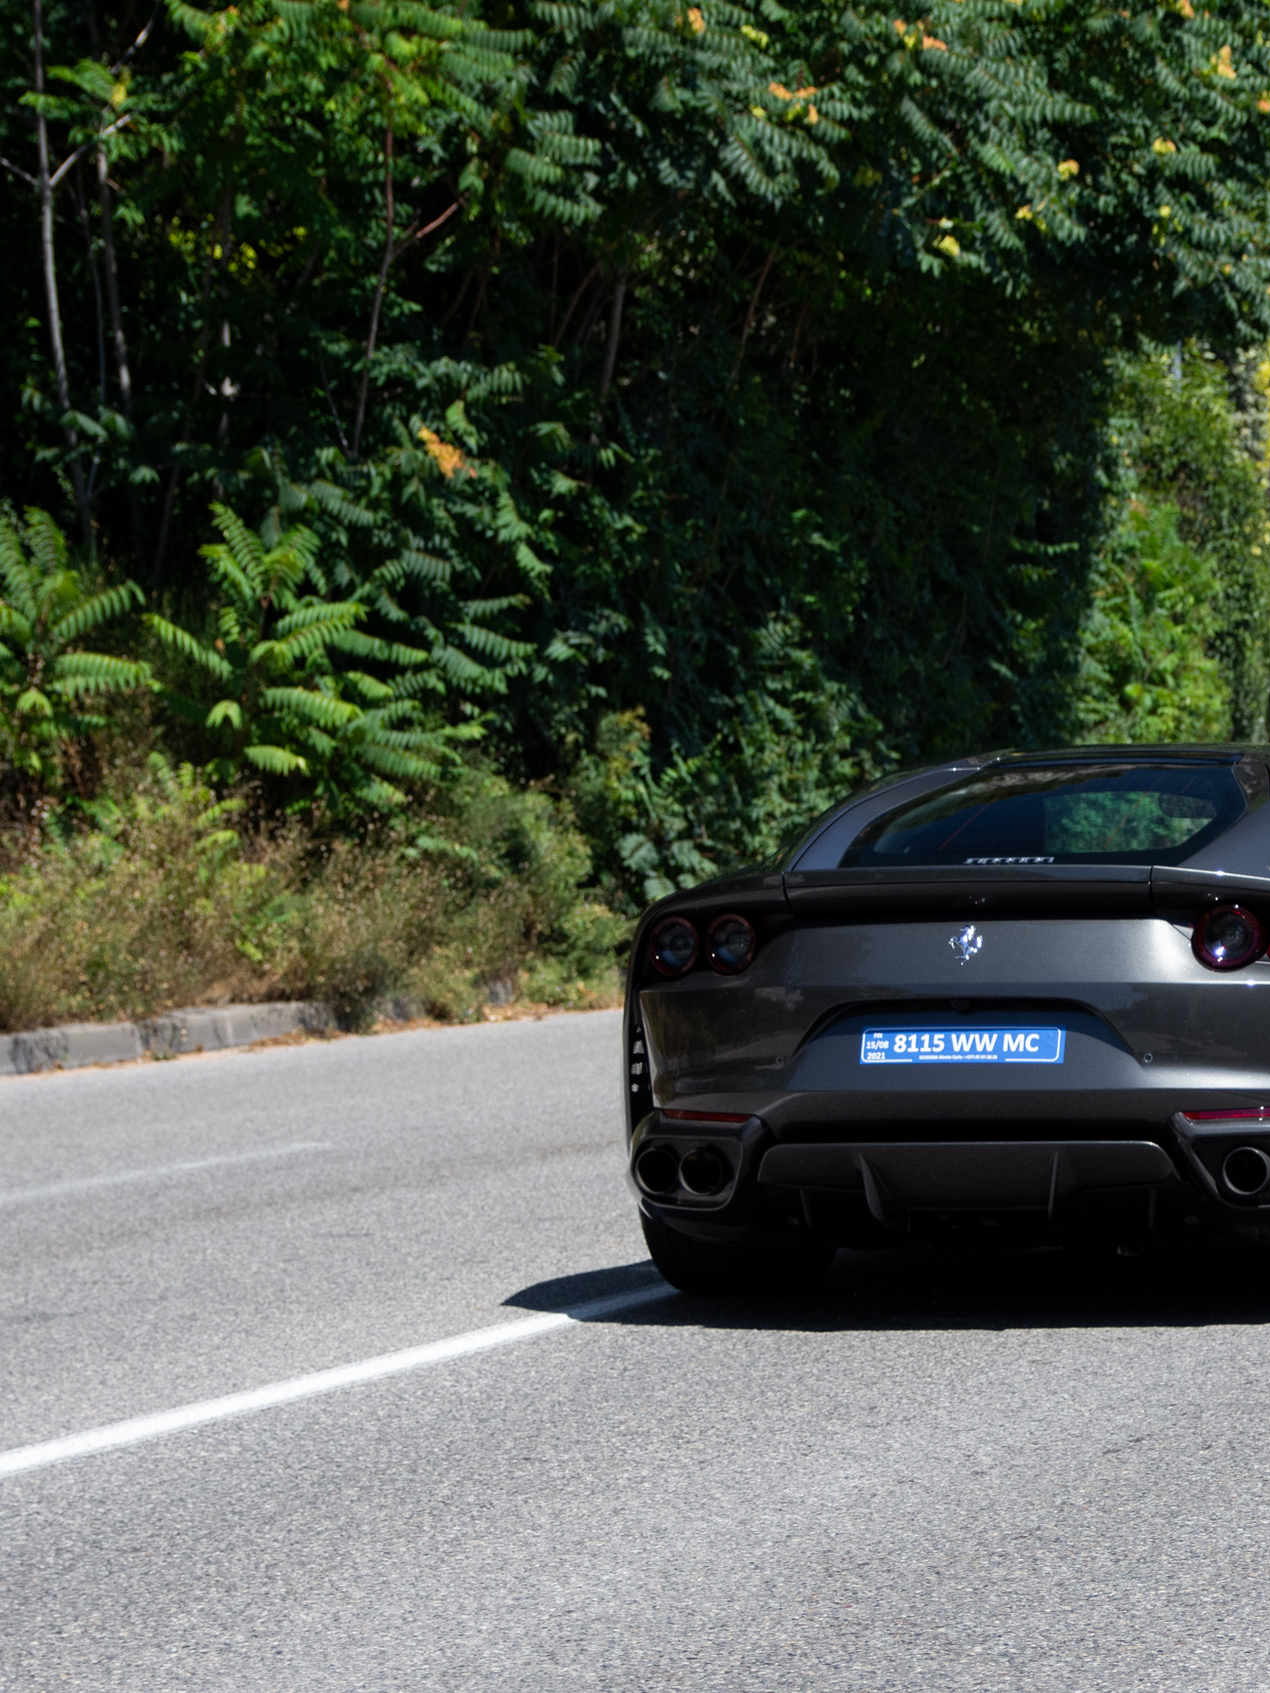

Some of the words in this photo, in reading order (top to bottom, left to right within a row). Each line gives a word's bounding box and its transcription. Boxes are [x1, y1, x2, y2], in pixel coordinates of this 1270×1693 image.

[866, 1040, 890, 1050] 15/08
[893, 1033, 946, 1053] 8115
[951, 1033, 998, 1052] WW
[1003, 1033, 1040, 1052] MC
[866, 1051, 886, 1060] 2021
